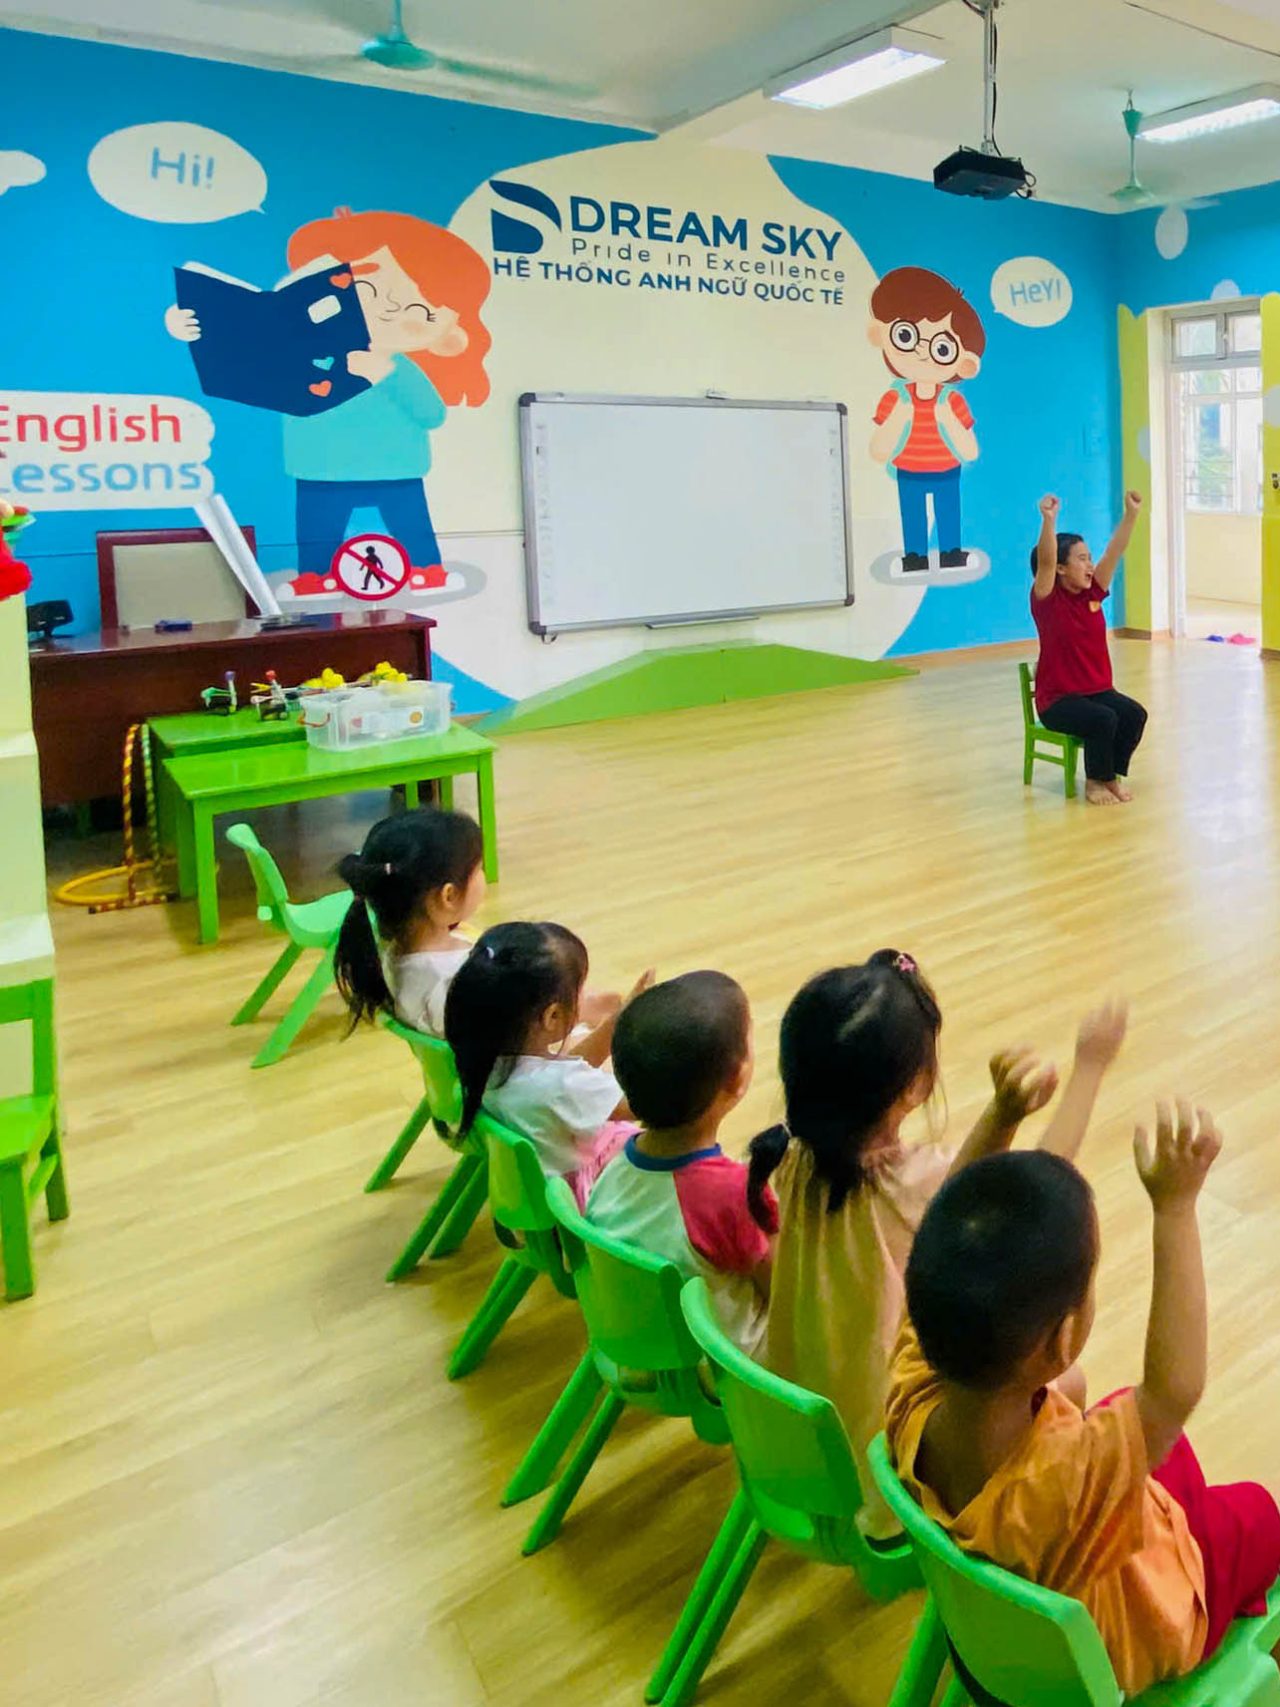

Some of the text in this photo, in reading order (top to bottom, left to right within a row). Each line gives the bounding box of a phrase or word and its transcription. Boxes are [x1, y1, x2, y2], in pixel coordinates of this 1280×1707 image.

[151, 146, 214, 190] Hi!
[570, 195, 842, 261] DREAM SKY
[572, 238, 845, 283] Pride in Excellence
[638, 271, 691, 292] ANH
